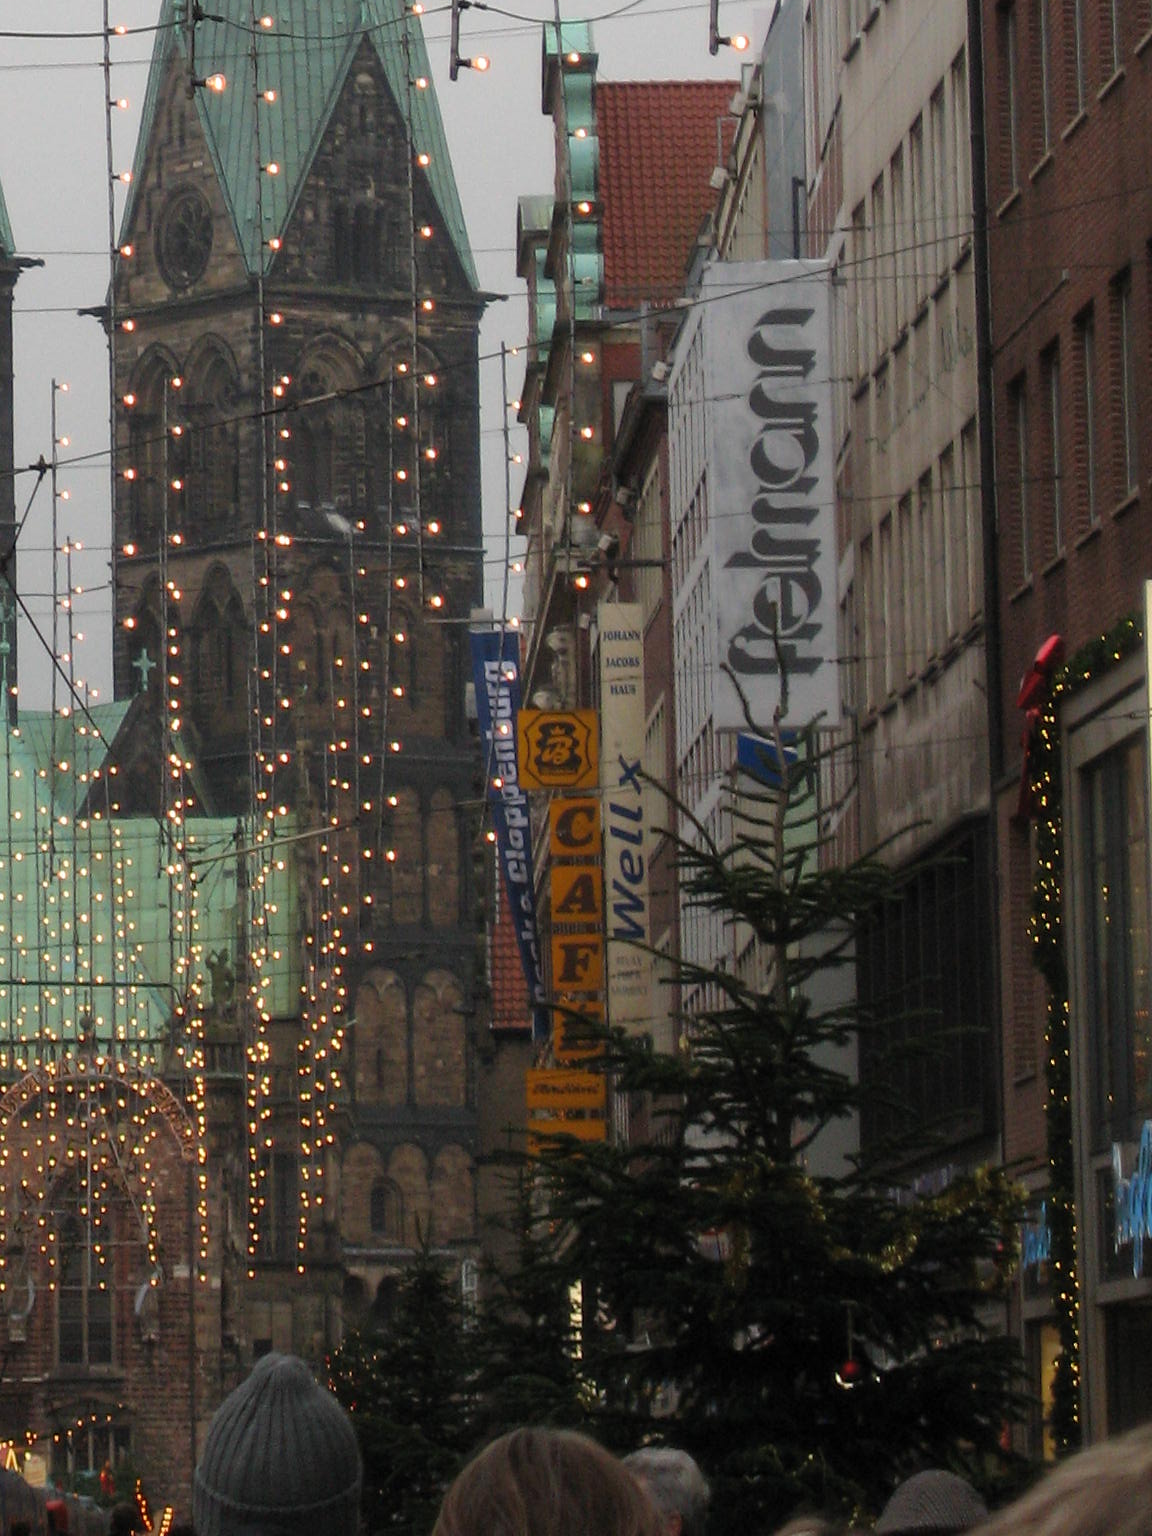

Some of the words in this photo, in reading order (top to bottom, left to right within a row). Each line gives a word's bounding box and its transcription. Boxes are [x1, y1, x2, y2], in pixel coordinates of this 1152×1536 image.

[603, 630, 641, 641] JOHANN
[606, 656, 640, 668] JACOBS
[610, 684, 636, 696] HAUS
[483, 660, 530, 883] Cloppenburg
